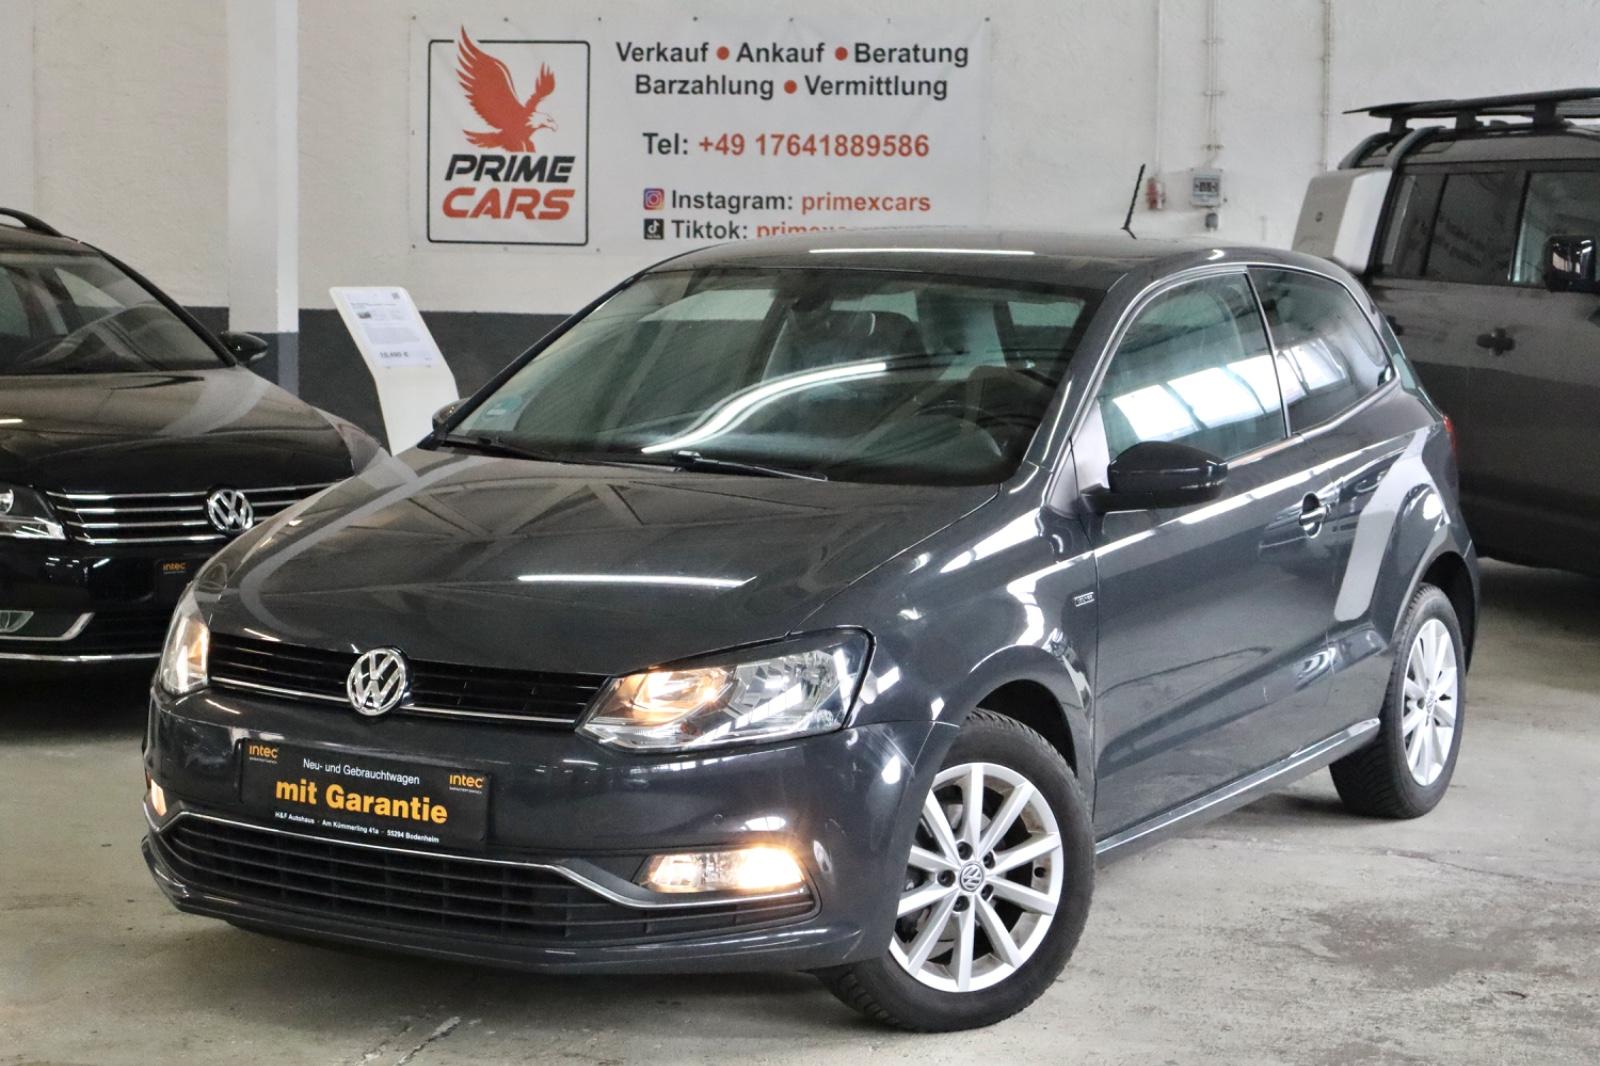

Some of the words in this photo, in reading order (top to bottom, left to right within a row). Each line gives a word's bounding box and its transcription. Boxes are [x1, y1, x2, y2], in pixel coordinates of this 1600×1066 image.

[616, 41, 709, 63] Verkauf
[736, 42, 825, 63] Ankauf
[854, 42, 969, 68] Beratung
[635, 74, 774, 101] Barzahlung
[804, 75, 948, 101] Vermittlung
[642, 132, 688, 156] Tel:
[699, 132, 745, 156] +49
[755, 133, 930, 157] 17641889586
[445, 154, 575, 182] PRIME
[442, 187, 575, 220] CARS
[671, 190, 793, 214] Instagram:
[801, 192, 931, 215] primexcars
[671, 219, 748, 240] Tiktok:
[249, 744, 279, 759] intec
[303, 758, 323, 770] Neu-
[325, 763, 341, 775] und
[343, 764, 420, 785] Gebrauchtwagen
[449, 774, 483, 789] intec
[275, 778, 318, 805] mit
[325, 784, 448, 824] Garantie
[322, 819, 333, 827] Am
